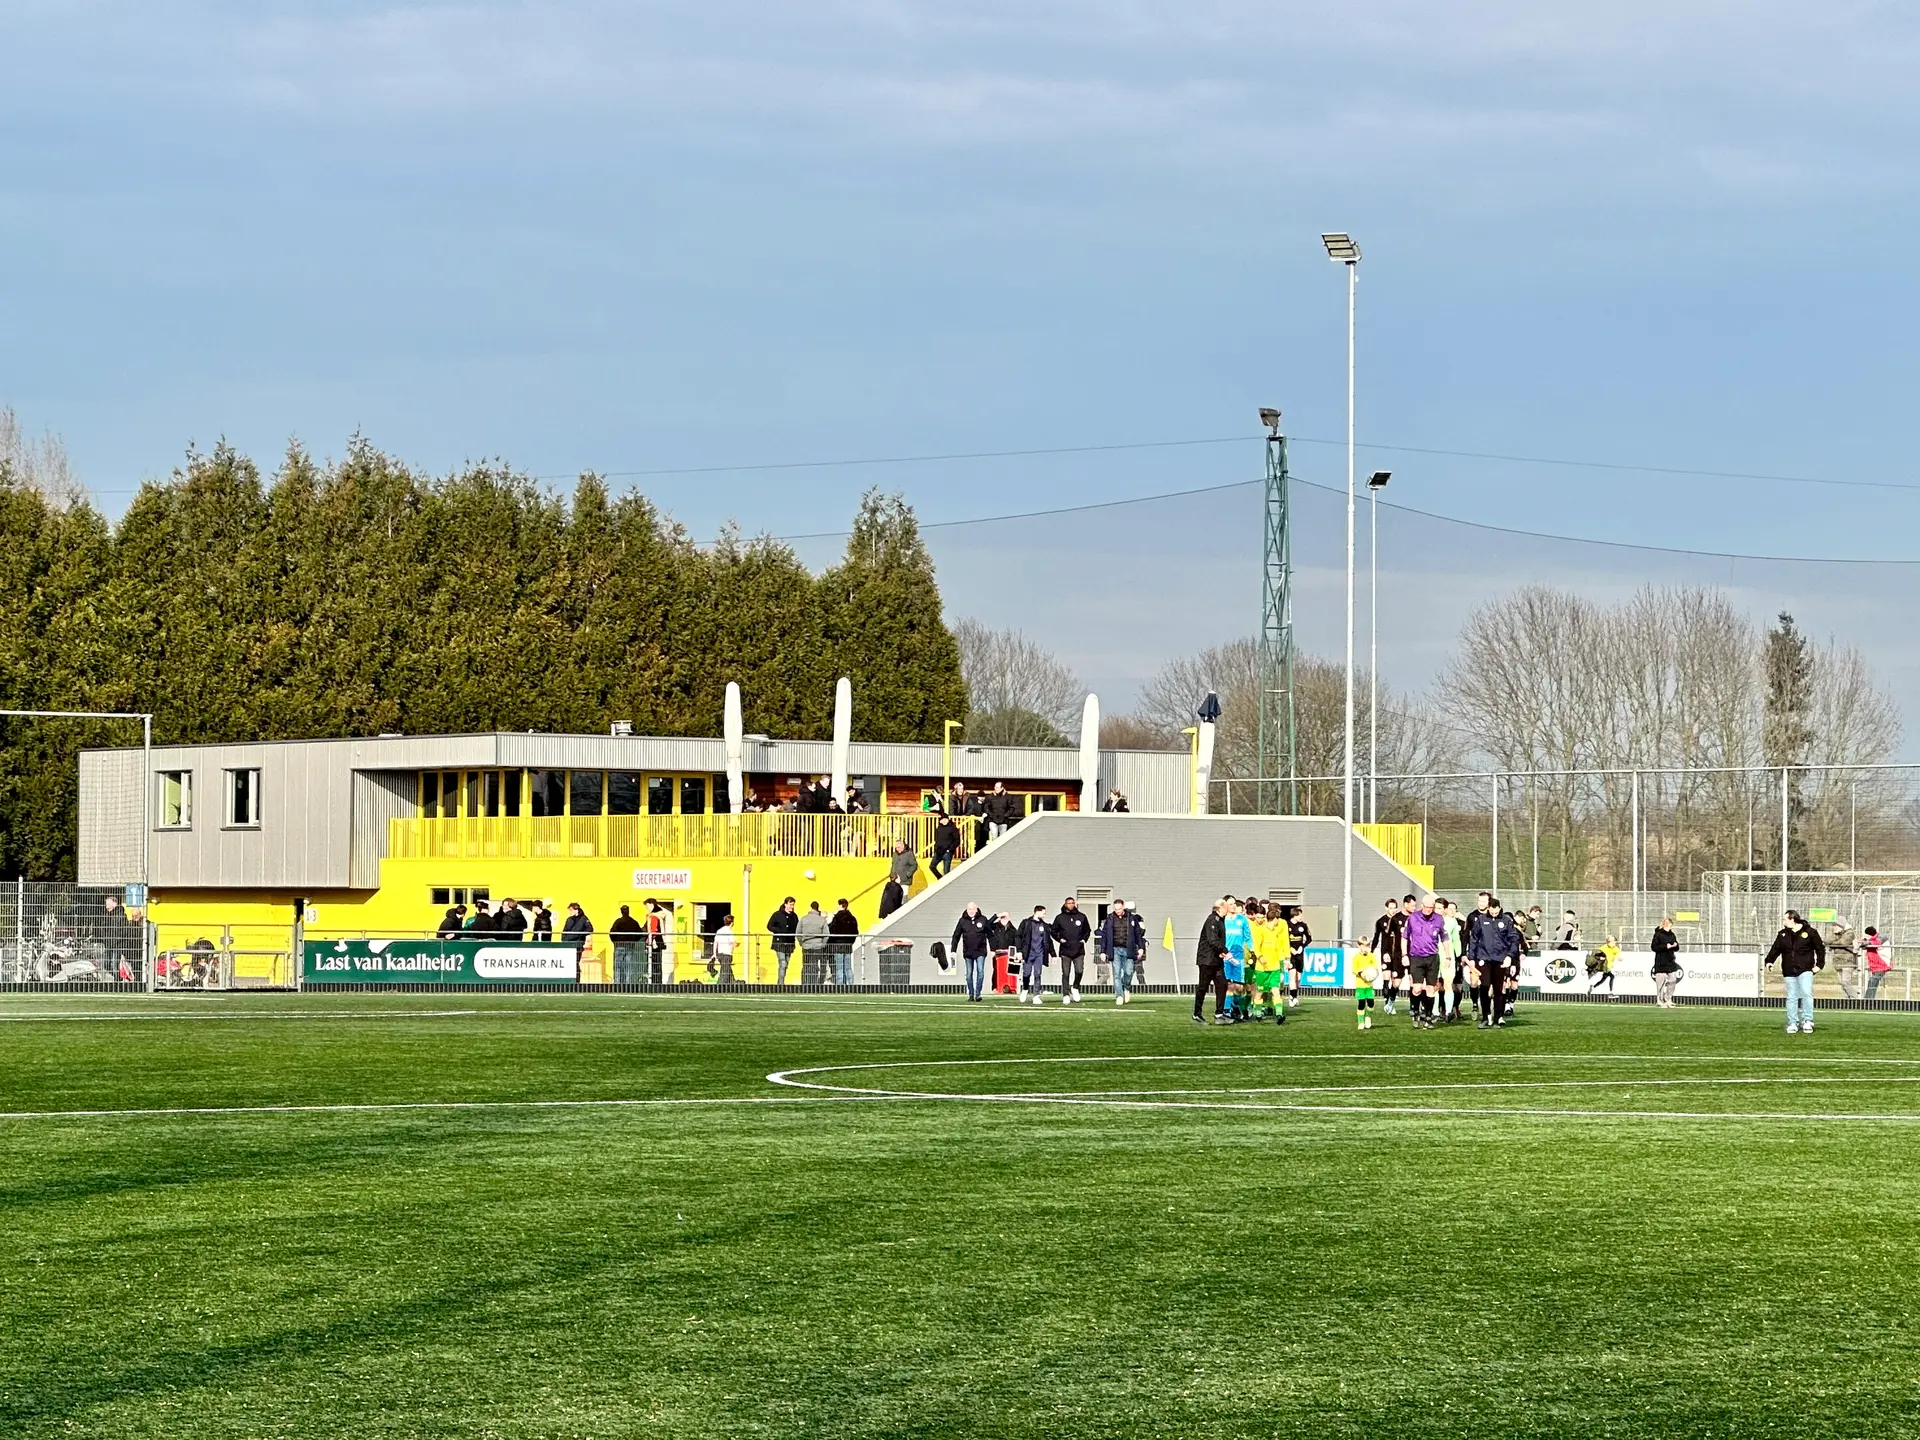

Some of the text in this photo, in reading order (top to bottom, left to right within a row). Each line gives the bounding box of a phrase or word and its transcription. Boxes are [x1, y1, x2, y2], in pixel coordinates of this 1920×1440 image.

[635, 873, 688, 885] SECRETARIAAT
[130, 886, 137, 906] 1
[315, 953, 465, 971] Last van kaalheid?
[483, 958, 565, 969] TRANSHAIR.NL
[1688, 970, 1712, 979] Groots
[1714, 971, 1721, 980] in
[1722, 972, 1755, 982] genieten
